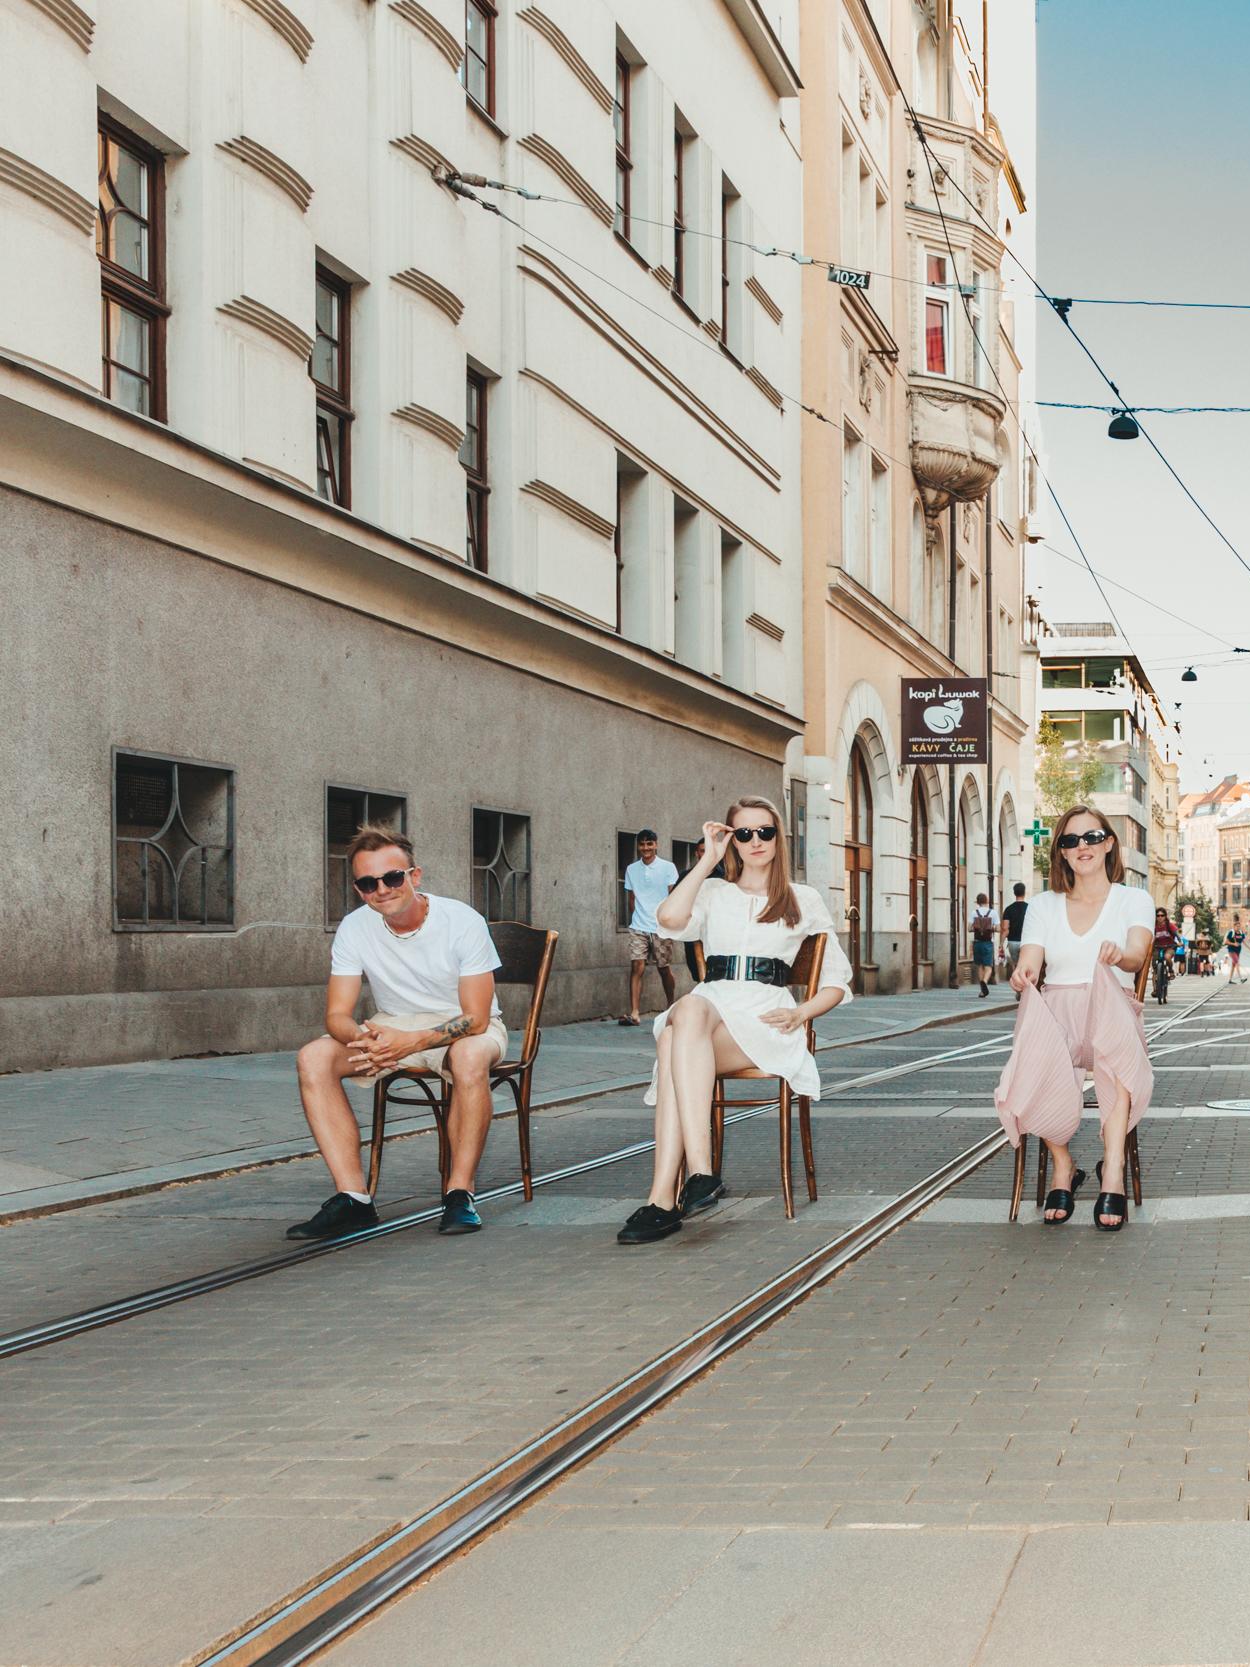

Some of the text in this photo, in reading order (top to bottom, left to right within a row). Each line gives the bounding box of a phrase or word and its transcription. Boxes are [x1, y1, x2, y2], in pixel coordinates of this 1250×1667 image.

[835, 270, 866, 287] 1024
[909, 687, 937, 702] kopi
[912, 743, 975, 752] KÁVY ČAJE
